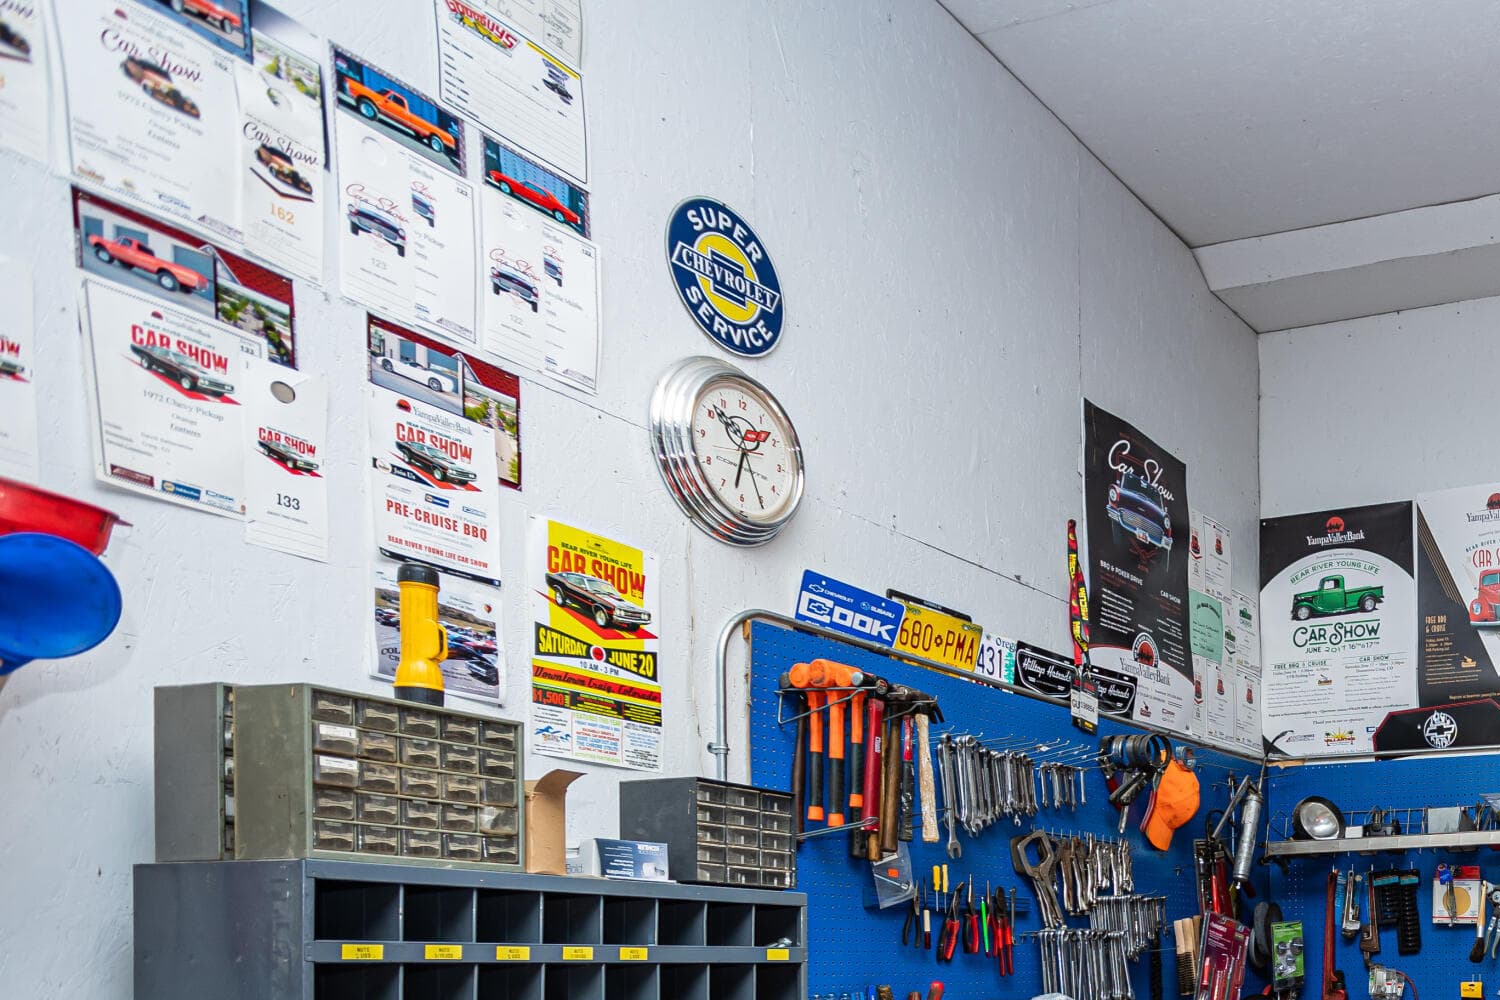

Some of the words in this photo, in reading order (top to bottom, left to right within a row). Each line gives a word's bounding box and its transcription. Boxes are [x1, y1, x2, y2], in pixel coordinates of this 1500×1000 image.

[100, 28, 141, 58] Car
[148, 48, 203, 83] Show
[243, 121, 274, 147] Car
[274, 138, 319, 166] Show
[269, 202, 296, 226] 162
[346, 183, 376, 206] Car
[377, 197, 410, 223] Show
[687, 206, 763, 263] SUPER
[370, 257, 388, 272] 123
[489, 248, 516, 266] Car
[516, 260, 542, 282] Show
[681, 247, 774, 308] CHEVROLET
[685, 285, 774, 348] SERVICE
[130, 324, 172, 351] CAR
[177, 338, 229, 376] SHOW
[195, 406, 224, 423] Pickup
[707, 408, 715, 419] 10
[720, 399, 727, 409] 11
[738, 400, 748, 411] 12
[413, 406, 473, 436] YampaValleyBank
[258, 426, 282, 443] CAR
[283, 434, 317, 458] SHOW
[395, 421, 426, 444] CAR
[430, 434, 473, 463] SHOW
[1108, 439, 1134, 474] Car
[1140, 459, 1175, 502] Show
[276, 493, 301, 511] 133
[386, 498, 458, 533] PRE-CRUISE
[463, 521, 488, 543] BBQ
[1306, 529, 1366, 547] YampaValleyBank
[561, 541, 578, 554] BEAR
[579, 545, 597, 559] RIVER
[599, 551, 619, 566] YOUNG
[620, 558, 633, 570] LIFE
[1472, 549, 1492, 568] CAR
[547, 545, 586, 576] CAR
[591, 560, 646, 600] SHOW
[1290, 569, 1311, 584] BEAR
[1311, 561, 1335, 573] RIVER
[1335, 559, 1362, 569] YOUNG
[1363, 563, 1380, 575] LIFE
[823, 588, 855, 603] CHEVROLET
[869, 604, 896, 619] SUBARU
[539, 628, 588, 657] SATURDAY
[899, 617, 934, 652] 680
[943, 630, 975, 666] PMA
[1293, 626, 1328, 648] CAR
[1329, 622, 1381, 646] SHOW
[608, 650, 637, 672] JUNE
[638, 653, 654, 677] 20
[977, 643, 1003, 679] 431
[1305, 646, 1321, 654] JUNE
[579, 659, 587, 669] 10
[587, 661, 600, 672] AM
[609, 666, 620, 677] PM
[1022, 658, 1046, 678] Hilltop
[532, 688, 565, 706] $1,500
[534, 664, 585, 689] Downtown
[617, 681, 660, 704] Colorado
